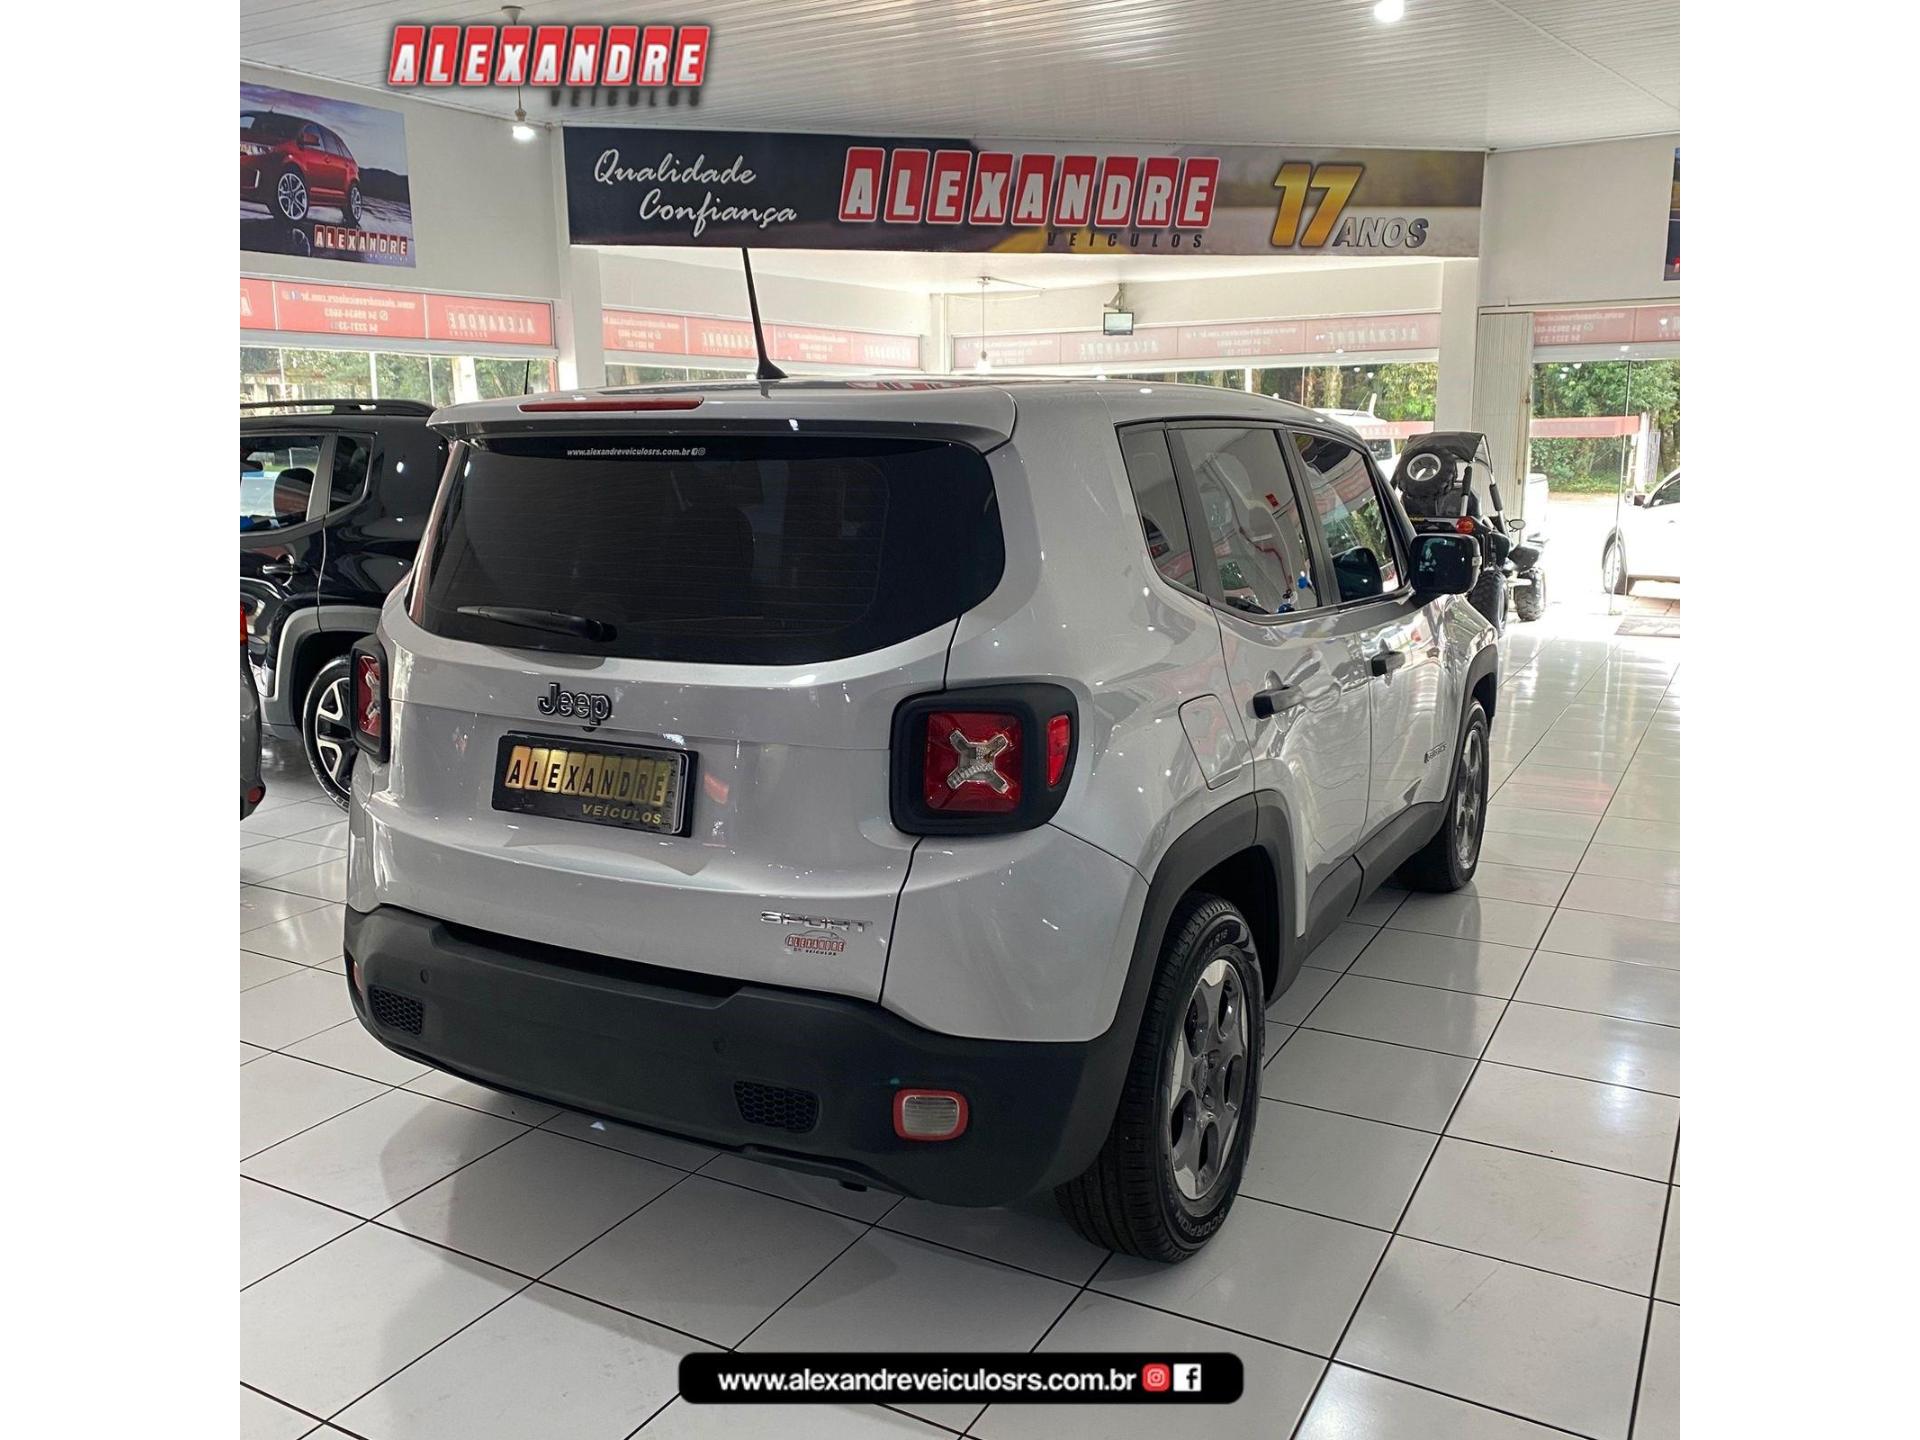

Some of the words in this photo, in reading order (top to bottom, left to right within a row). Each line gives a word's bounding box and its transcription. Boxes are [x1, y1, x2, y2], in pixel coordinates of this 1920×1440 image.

[594, 148, 757, 185] Qualidade
[639, 188, 798, 238] Confiança
[844, 165, 1210, 223] ALEXANDRE
[1270, 161, 1365, 248] 17
[1332, 215, 1430, 249] ANOS
[315, 229, 408, 256] ALEXANDRE
[537, 682, 613, 726] Jeep
[507, 757, 668, 803] ALEXANDRE
[760, 910, 873, 933] SPORT
[787, 936, 845, 952] ALEXANDRE
